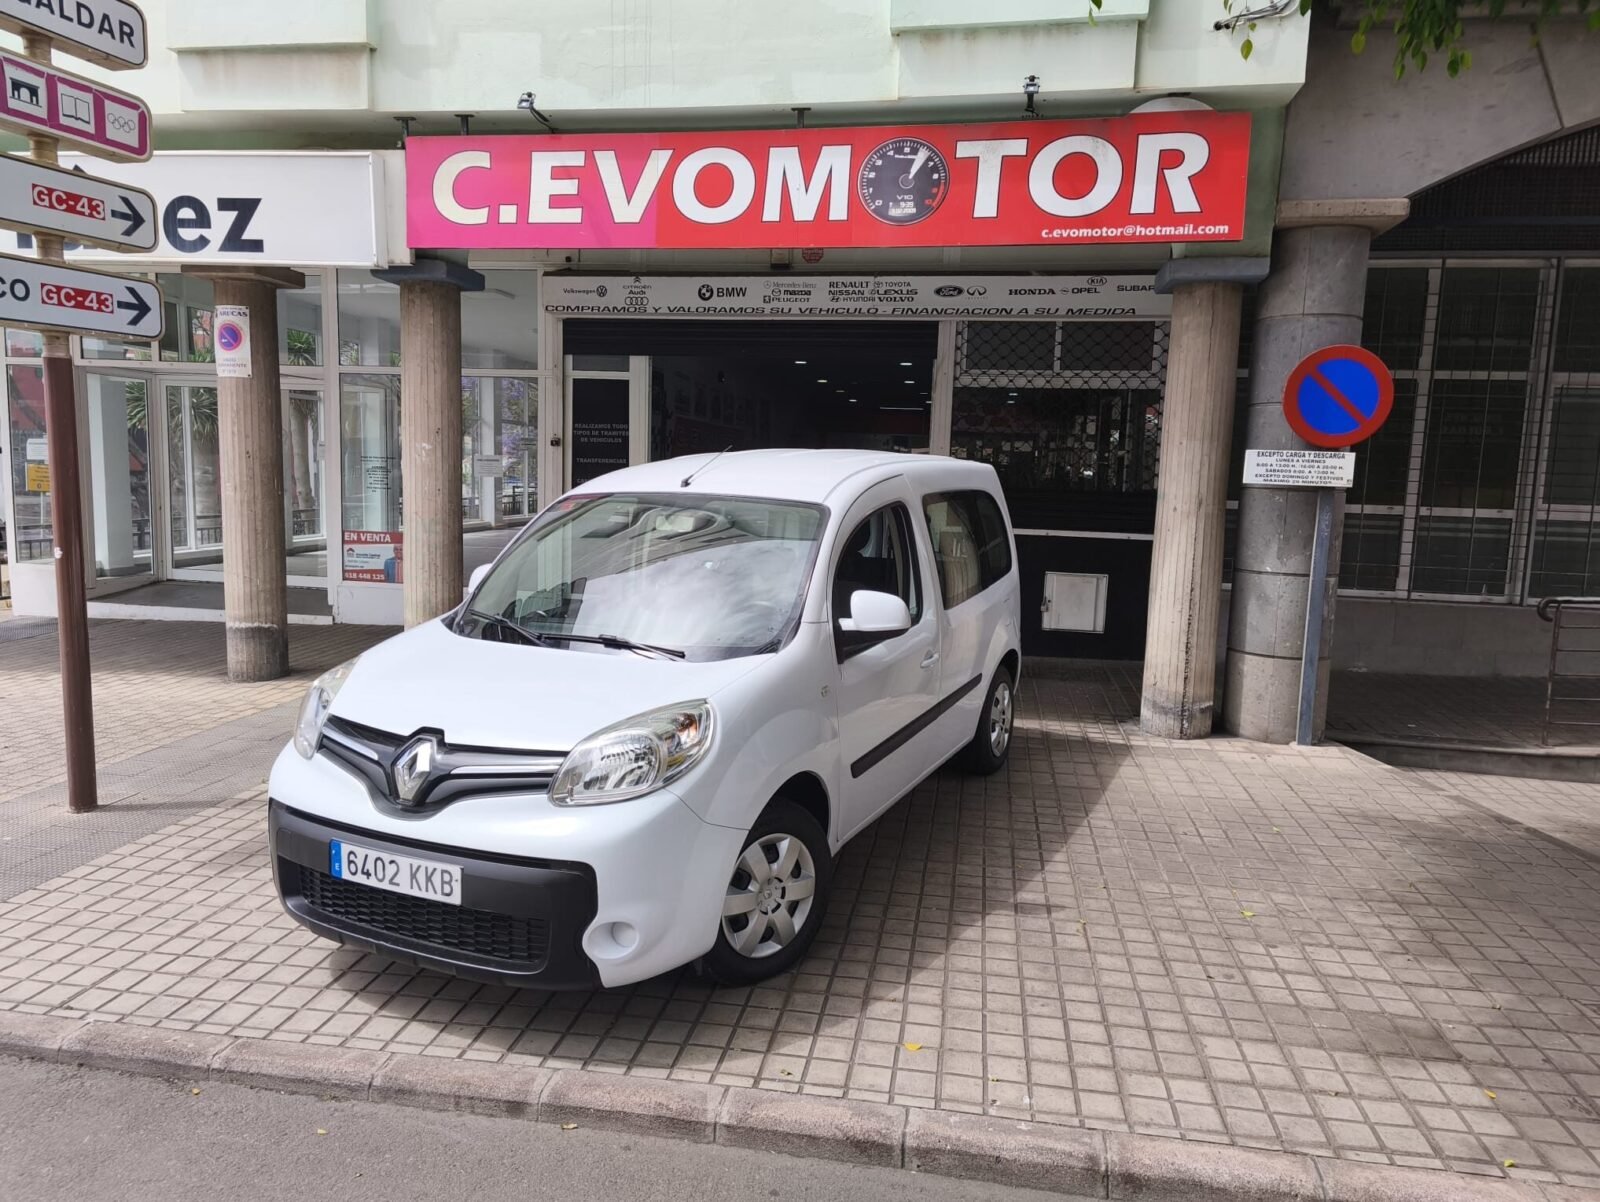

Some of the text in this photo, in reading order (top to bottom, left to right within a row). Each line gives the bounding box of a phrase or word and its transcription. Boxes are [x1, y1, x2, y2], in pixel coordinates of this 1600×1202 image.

[17, 0, 136, 48] ALDAR
[33, 186, 105, 220] GC-43
[1041, 224, 1229, 238] c.evomotor@hotmail.com
[42, 284, 114, 313] GC-43
[717, 287, 747, 297] BMW
[545, 305, 647, 313] COMPRAMOS
[344, 532, 391, 542] EN VENTA
[347, 851, 400, 886] 6402
[410, 863, 454, 896] KKB
